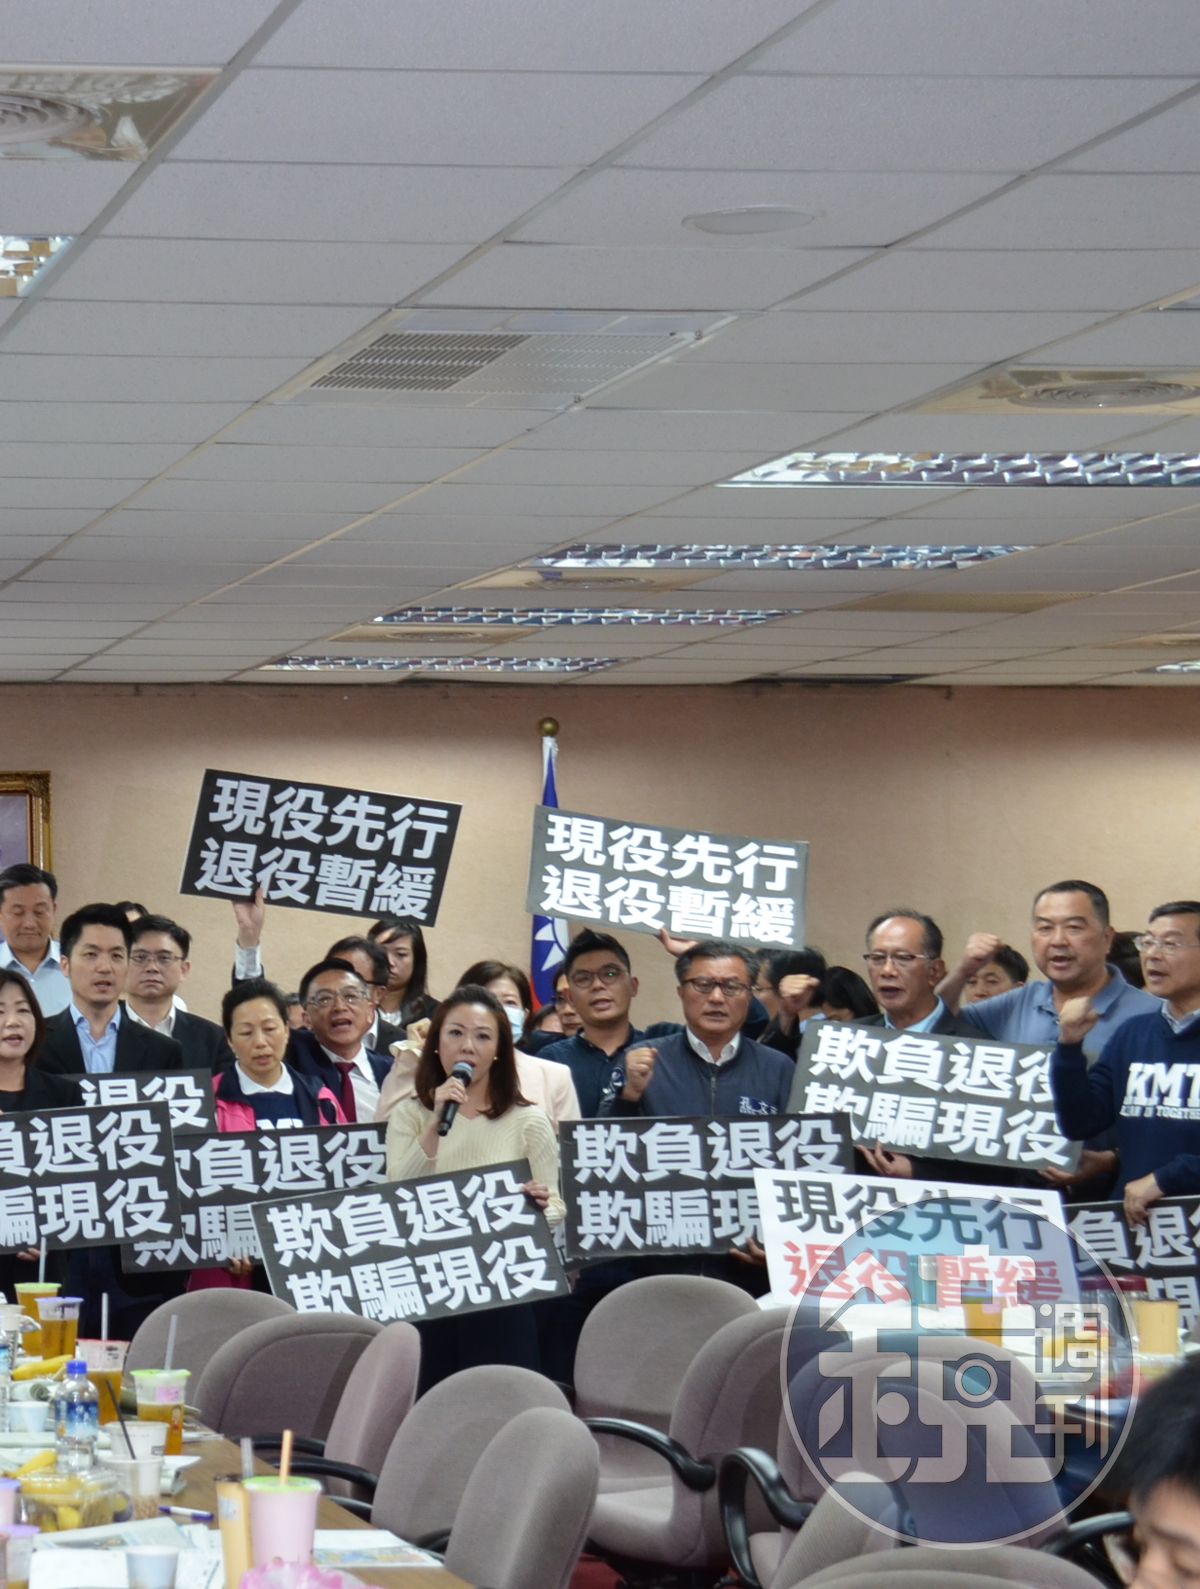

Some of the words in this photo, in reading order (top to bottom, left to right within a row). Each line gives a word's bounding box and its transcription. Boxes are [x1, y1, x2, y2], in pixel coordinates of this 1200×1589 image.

[208, 777, 448, 859] 現役先行
[545, 814, 799, 892] 現役先行
[195, 838, 436, 920] 退役暫緩
[539, 865, 795, 945] 退役暫緩
[799, 1082, 1072, 1166] 欺騙現役
[1123, 1062, 1200, 1108] KMT
[572, 1120, 845, 1184] 欺負退役
[266, 1169, 536, 1267] 欺負退役
[772, 1178, 1049, 1251] 現役先行
[286, 1235, 558, 1323] 欺騙現役
[783, 1240, 1064, 1310] 退役暫緩
